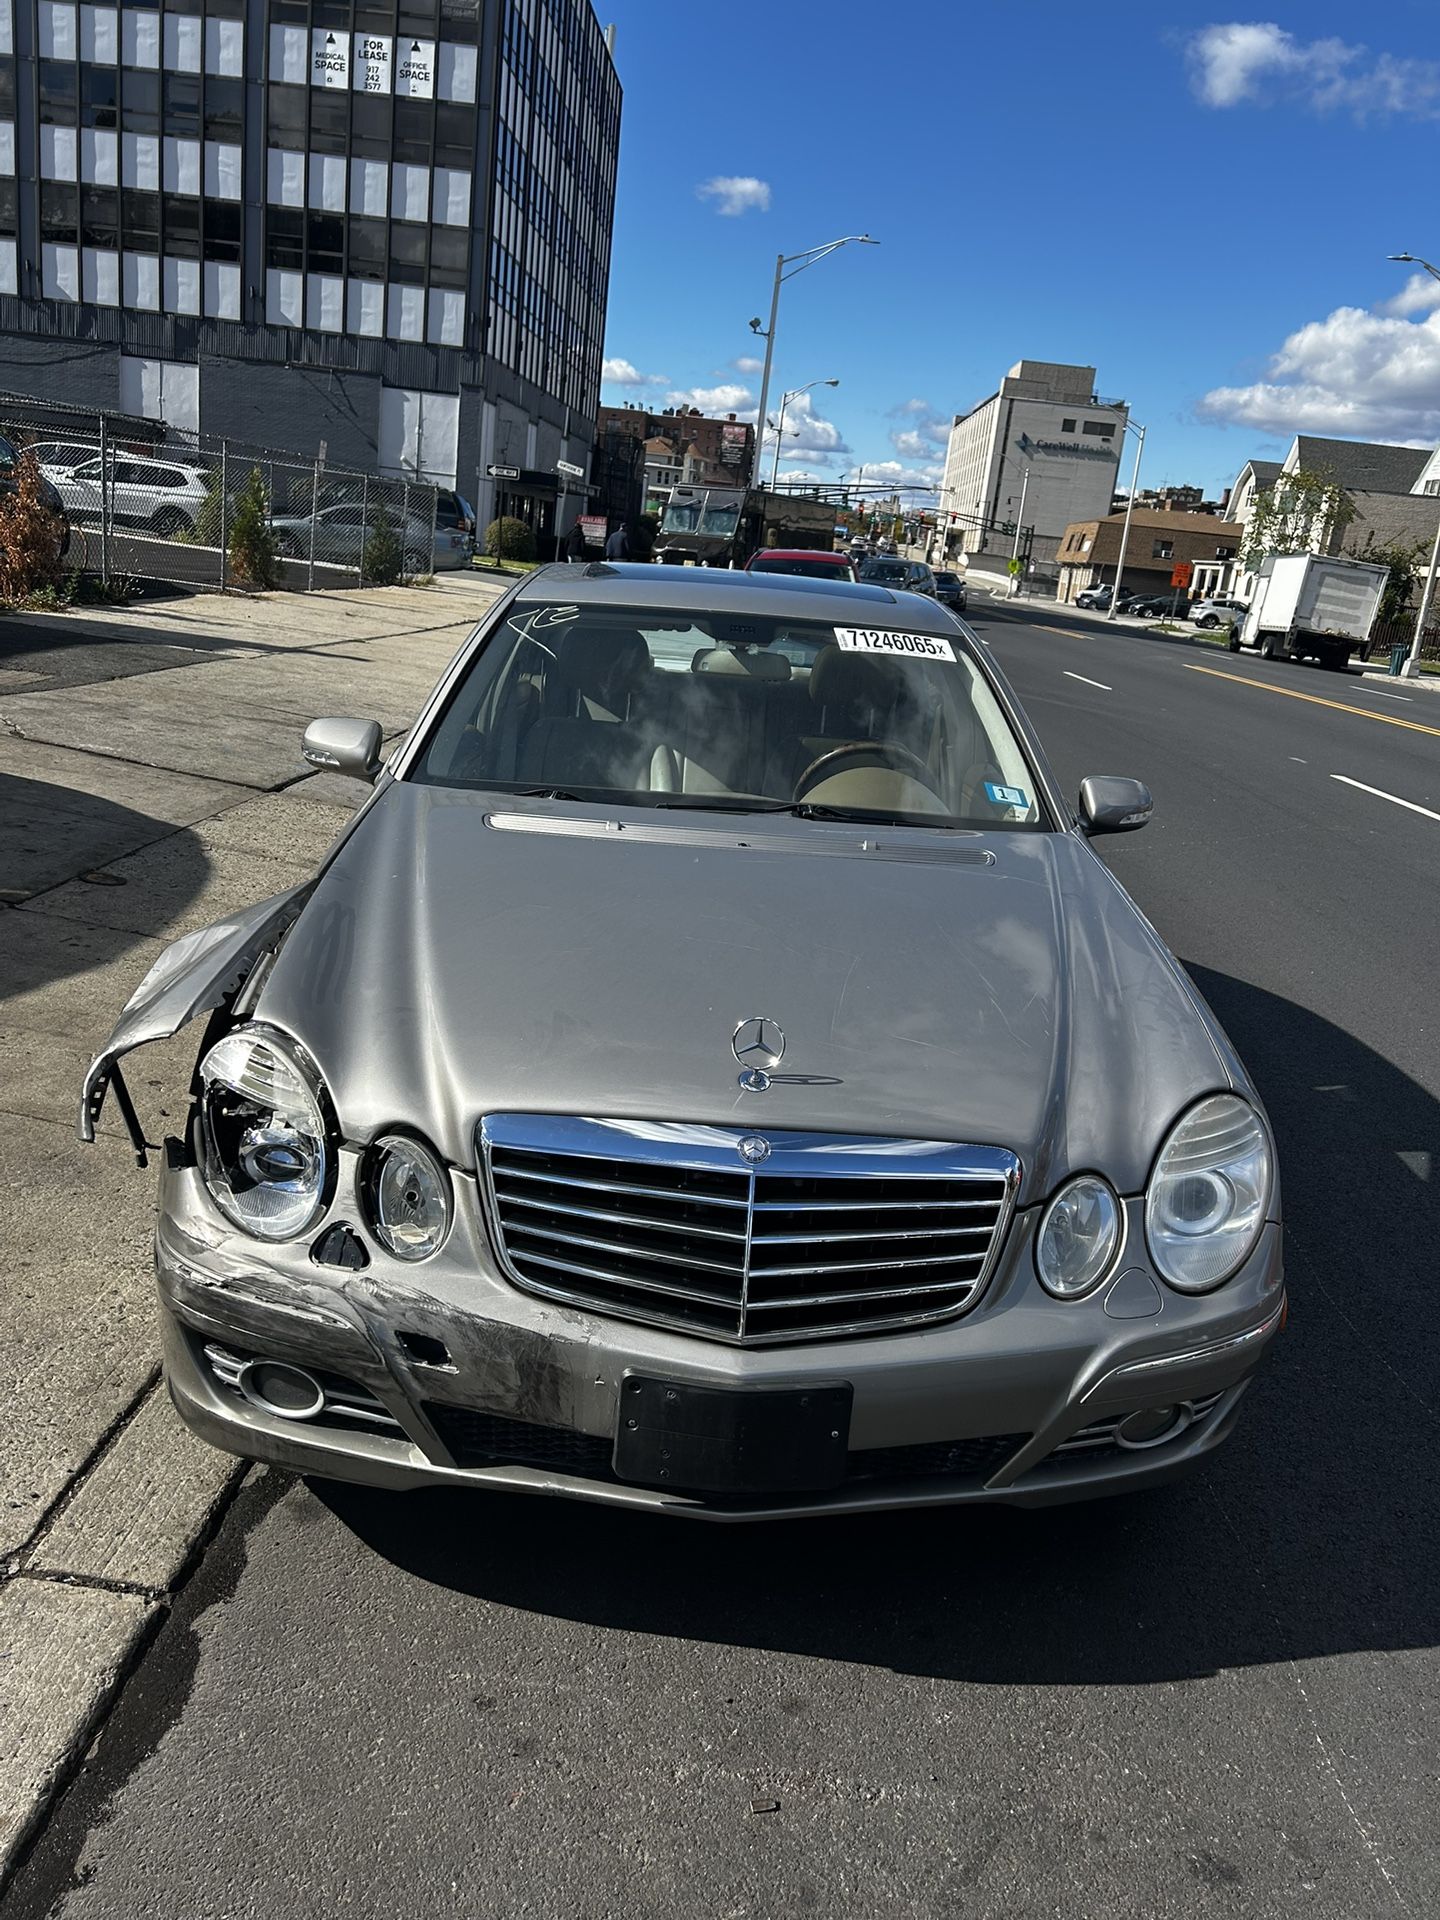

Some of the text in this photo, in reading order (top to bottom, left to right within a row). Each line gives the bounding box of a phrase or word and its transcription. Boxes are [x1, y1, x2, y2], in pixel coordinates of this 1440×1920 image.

[363, 40, 384, 50] FOR
[315, 52, 346, 61] MEDICAL
[358, 49, 388, 61] LEASE
[314, 60, 346, 72] SPACE
[366, 65, 380, 73] 917
[403, 61, 428, 70] OFFICE
[365, 74, 380, 82] 242
[399, 69, 430, 81] SPACE
[363, 82, 381, 91] 3577
[998, 788, 1009, 800] 1
